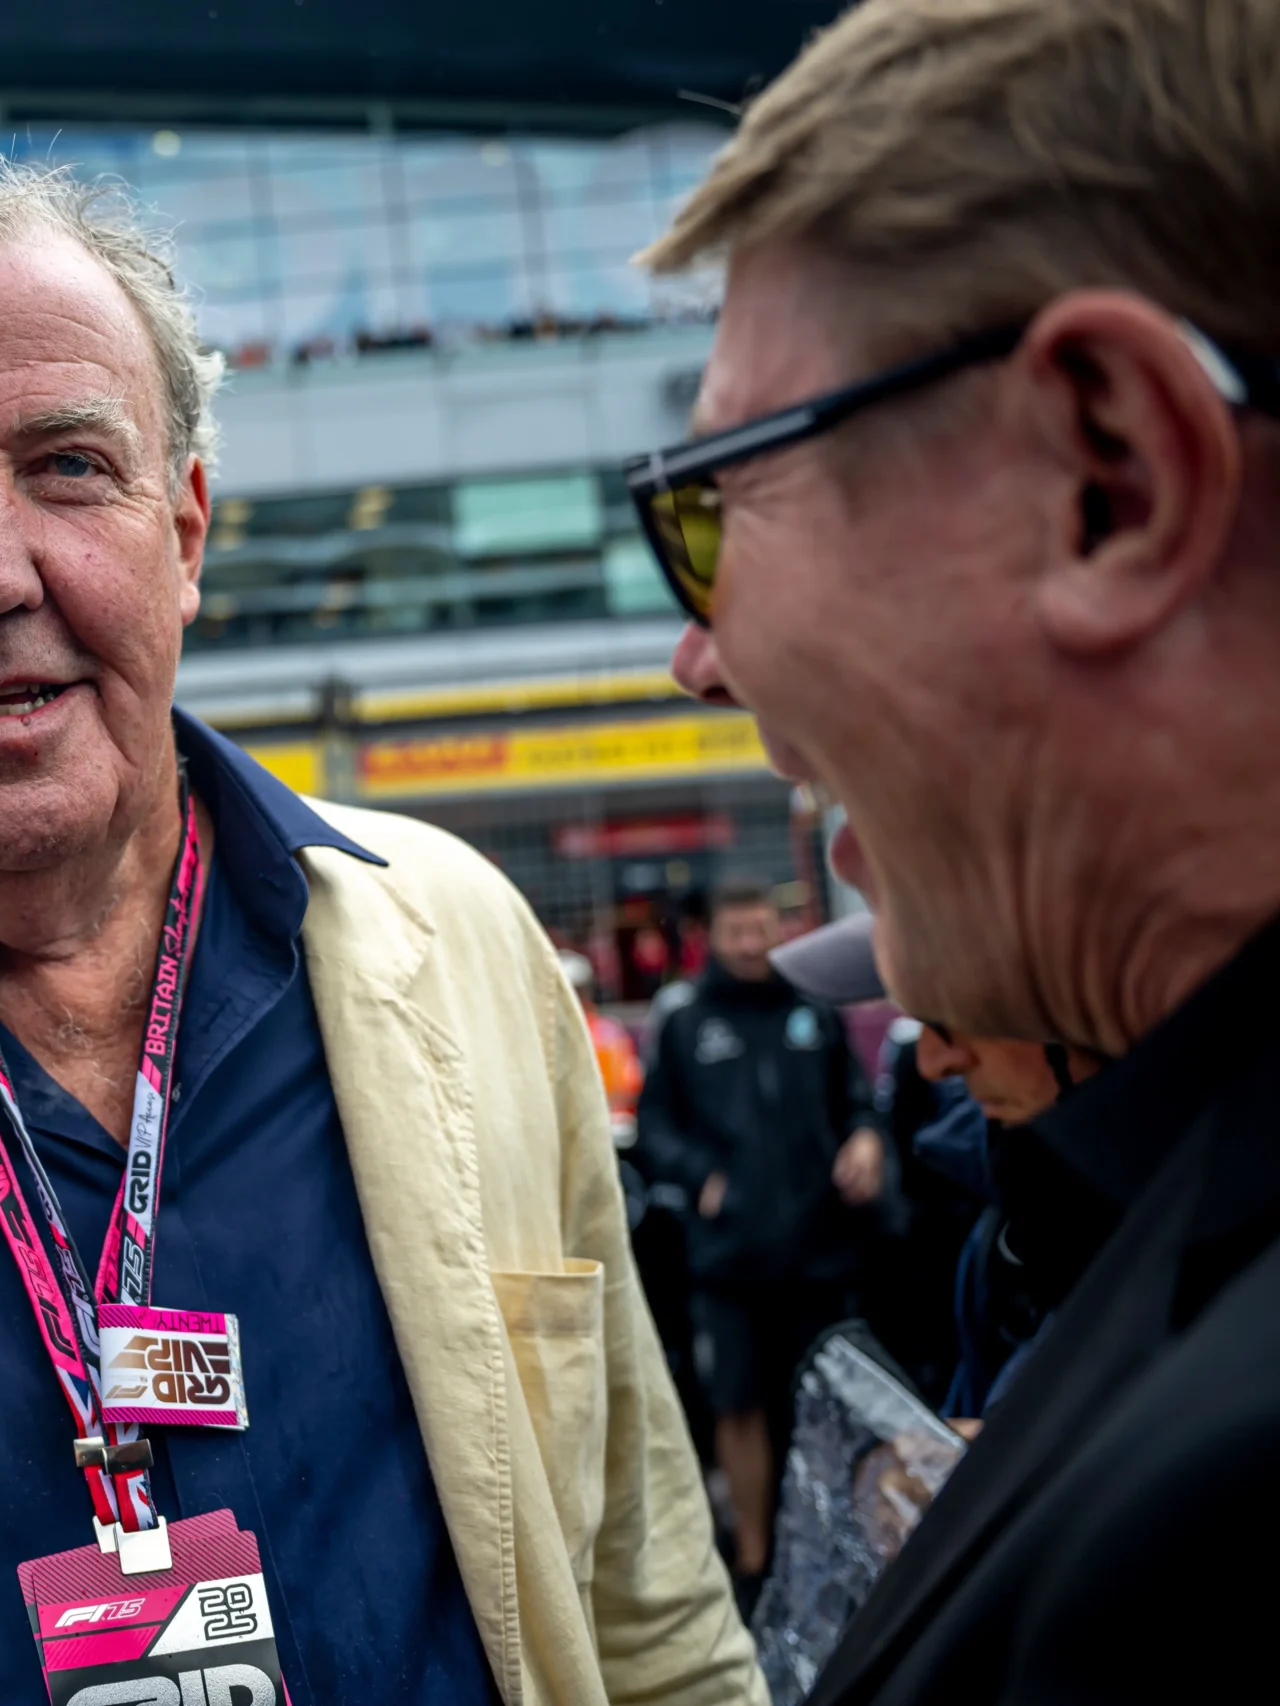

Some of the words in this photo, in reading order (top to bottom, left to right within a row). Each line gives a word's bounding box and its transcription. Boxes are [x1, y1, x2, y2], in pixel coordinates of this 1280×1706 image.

[145, 957, 178, 1056] BRITAIN
[128, 1150, 151, 1213] GRID
[156, 1312, 224, 1334] TWENTY
[152, 1372, 231, 1404] GRID
